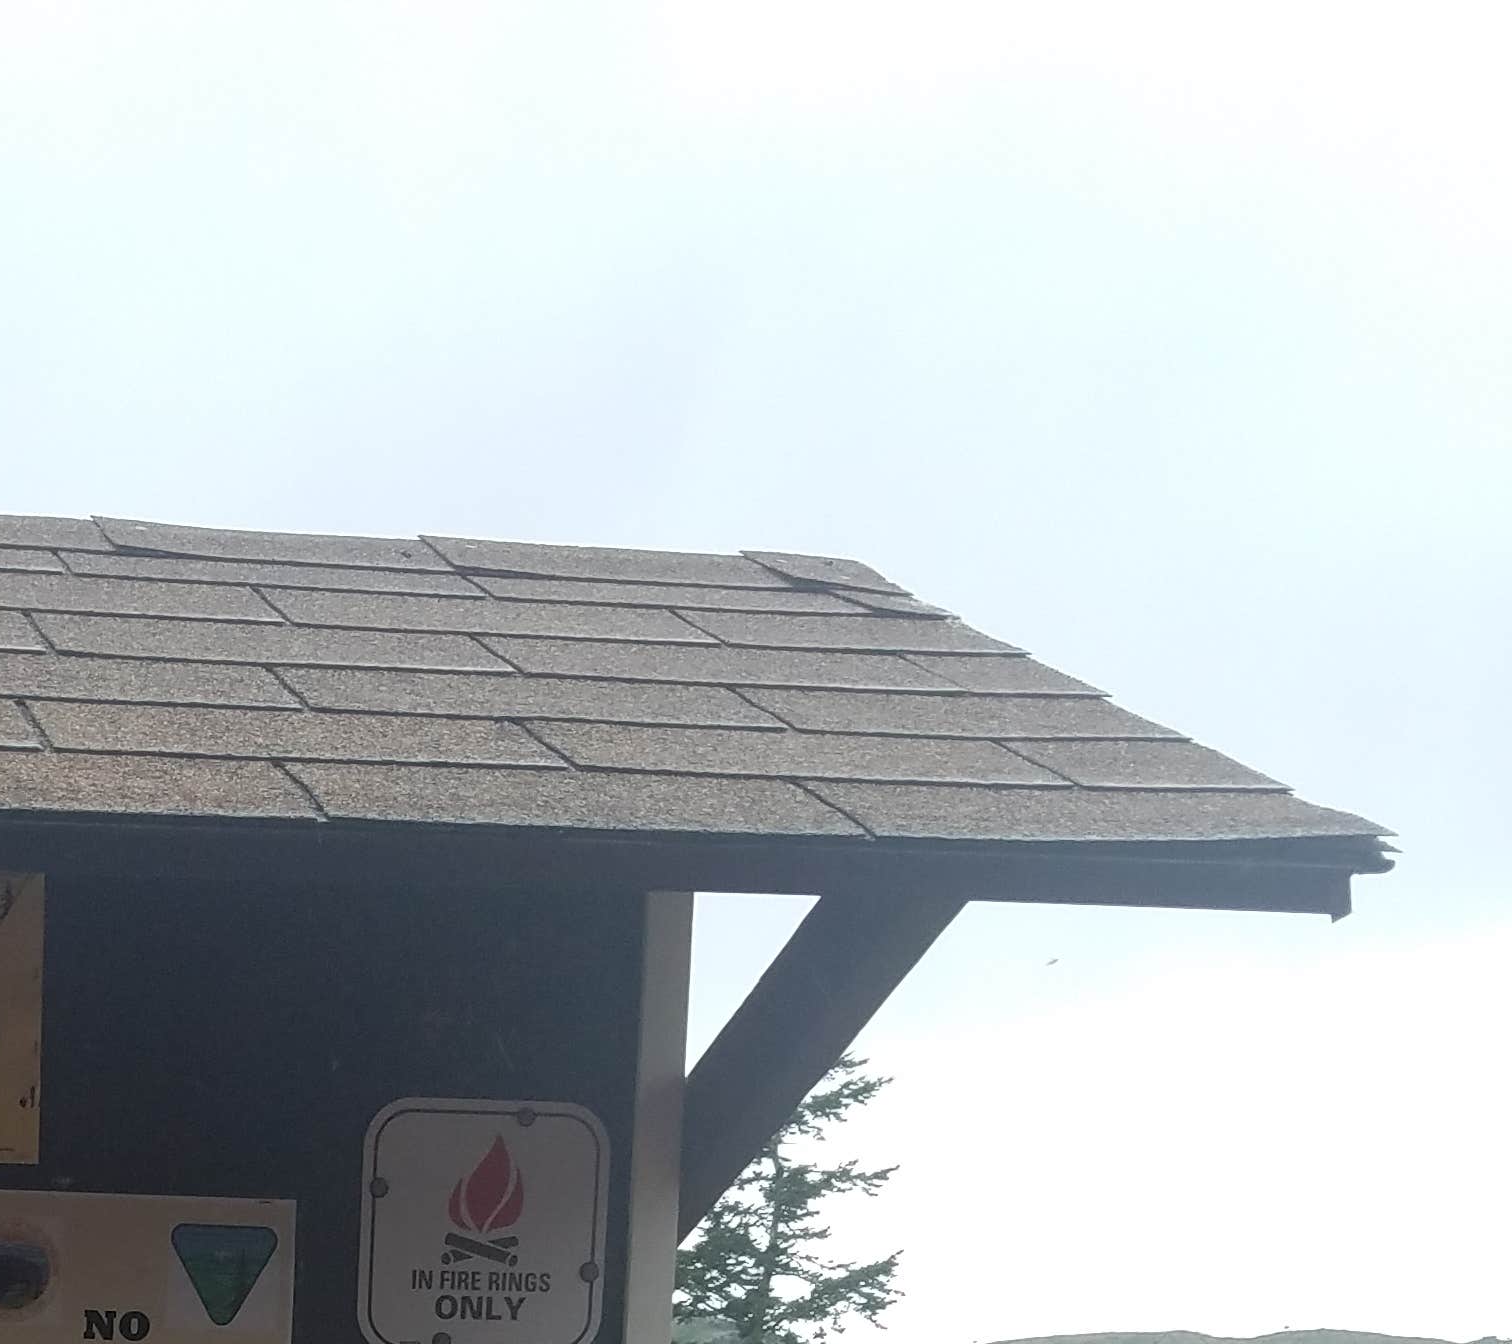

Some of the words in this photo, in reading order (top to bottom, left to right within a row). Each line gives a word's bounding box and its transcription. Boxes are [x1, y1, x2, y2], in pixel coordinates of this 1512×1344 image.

[412, 1269, 433, 1290] IN
[439, 1270, 481, 1291] FIRE
[488, 1272, 551, 1292] RINGS
[435, 1294, 526, 1320] ONLY
[83, 1309, 150, 1341] NO
